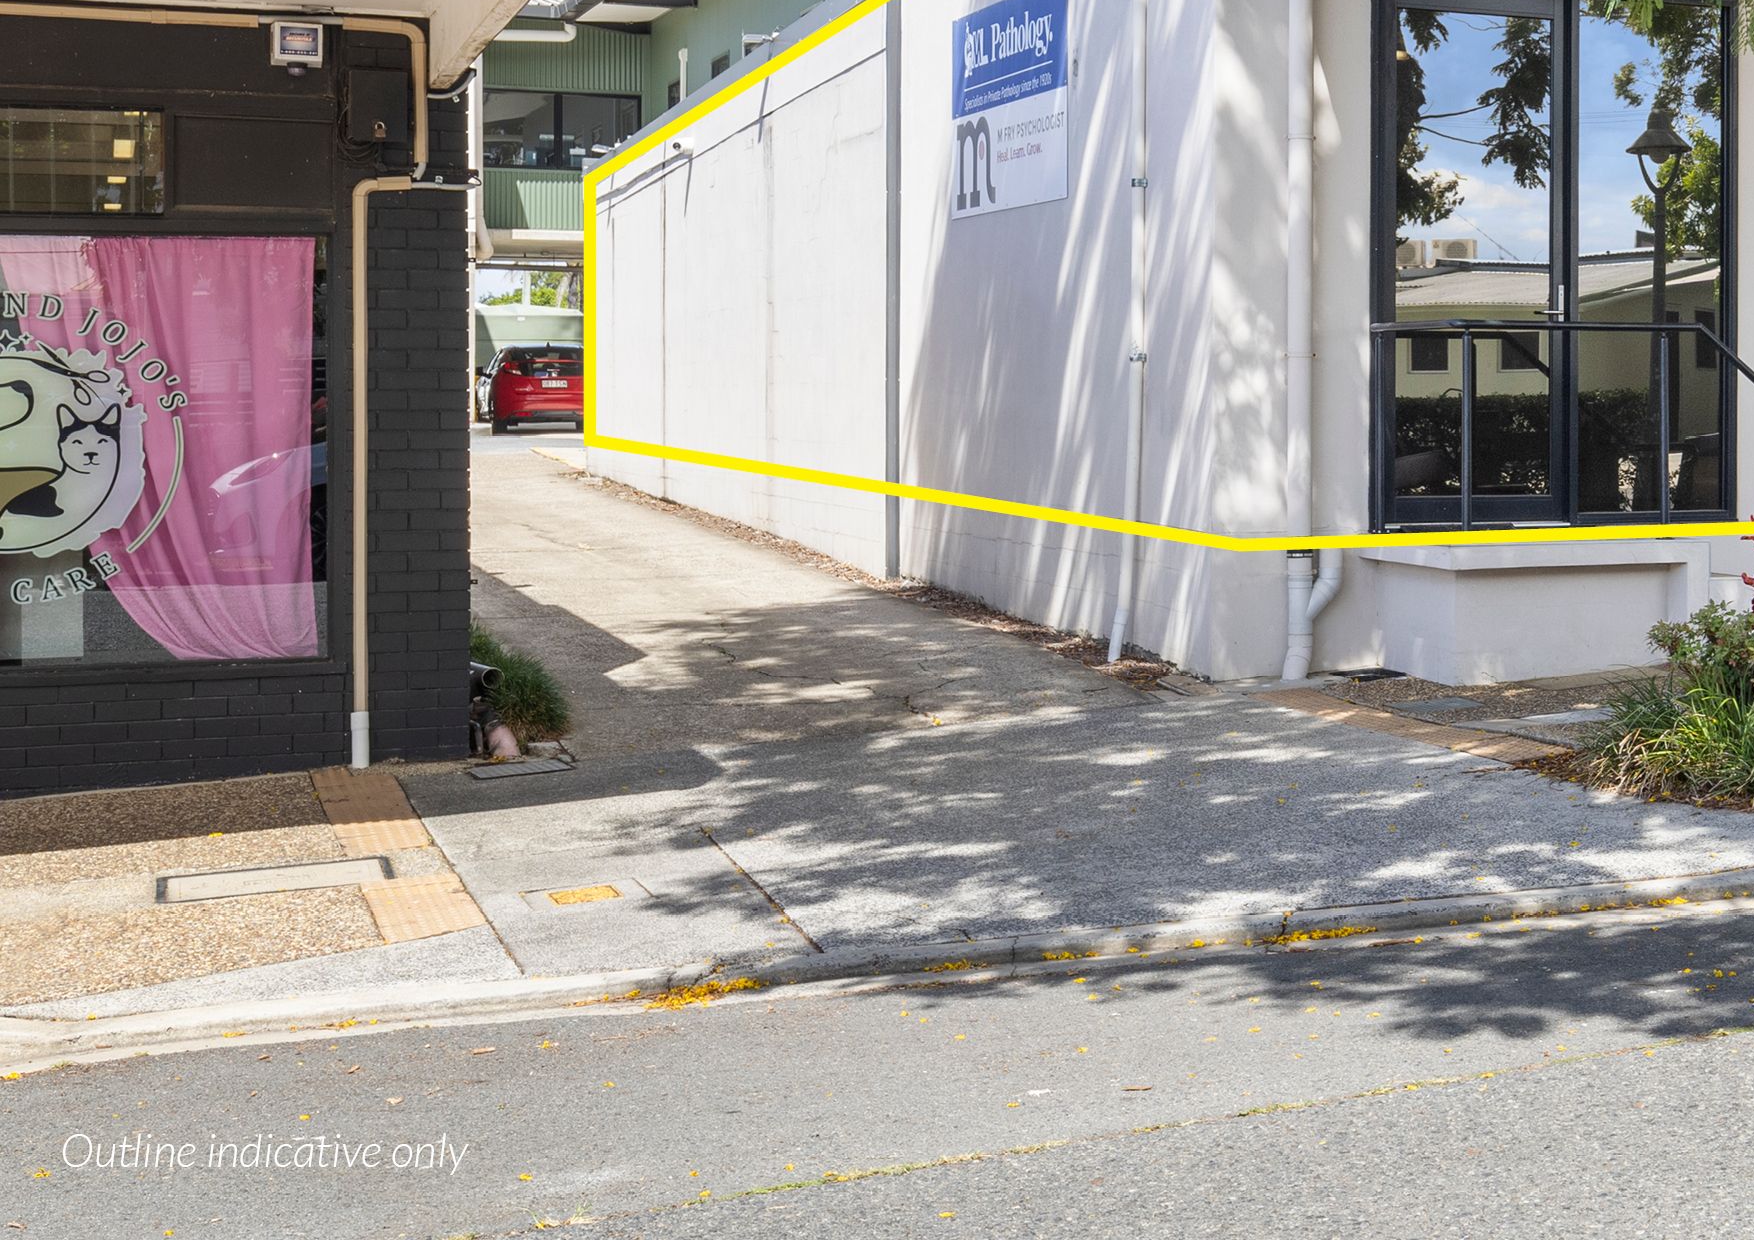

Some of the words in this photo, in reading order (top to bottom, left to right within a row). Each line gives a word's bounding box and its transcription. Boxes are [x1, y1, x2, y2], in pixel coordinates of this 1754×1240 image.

[1004, 123, 1015, 141] FRY
[1017, 111, 1064, 138] PSYCHOLOGIST
[78, 309, 187, 411] JOJO'S
[12, 551, 120, 604] CARE
